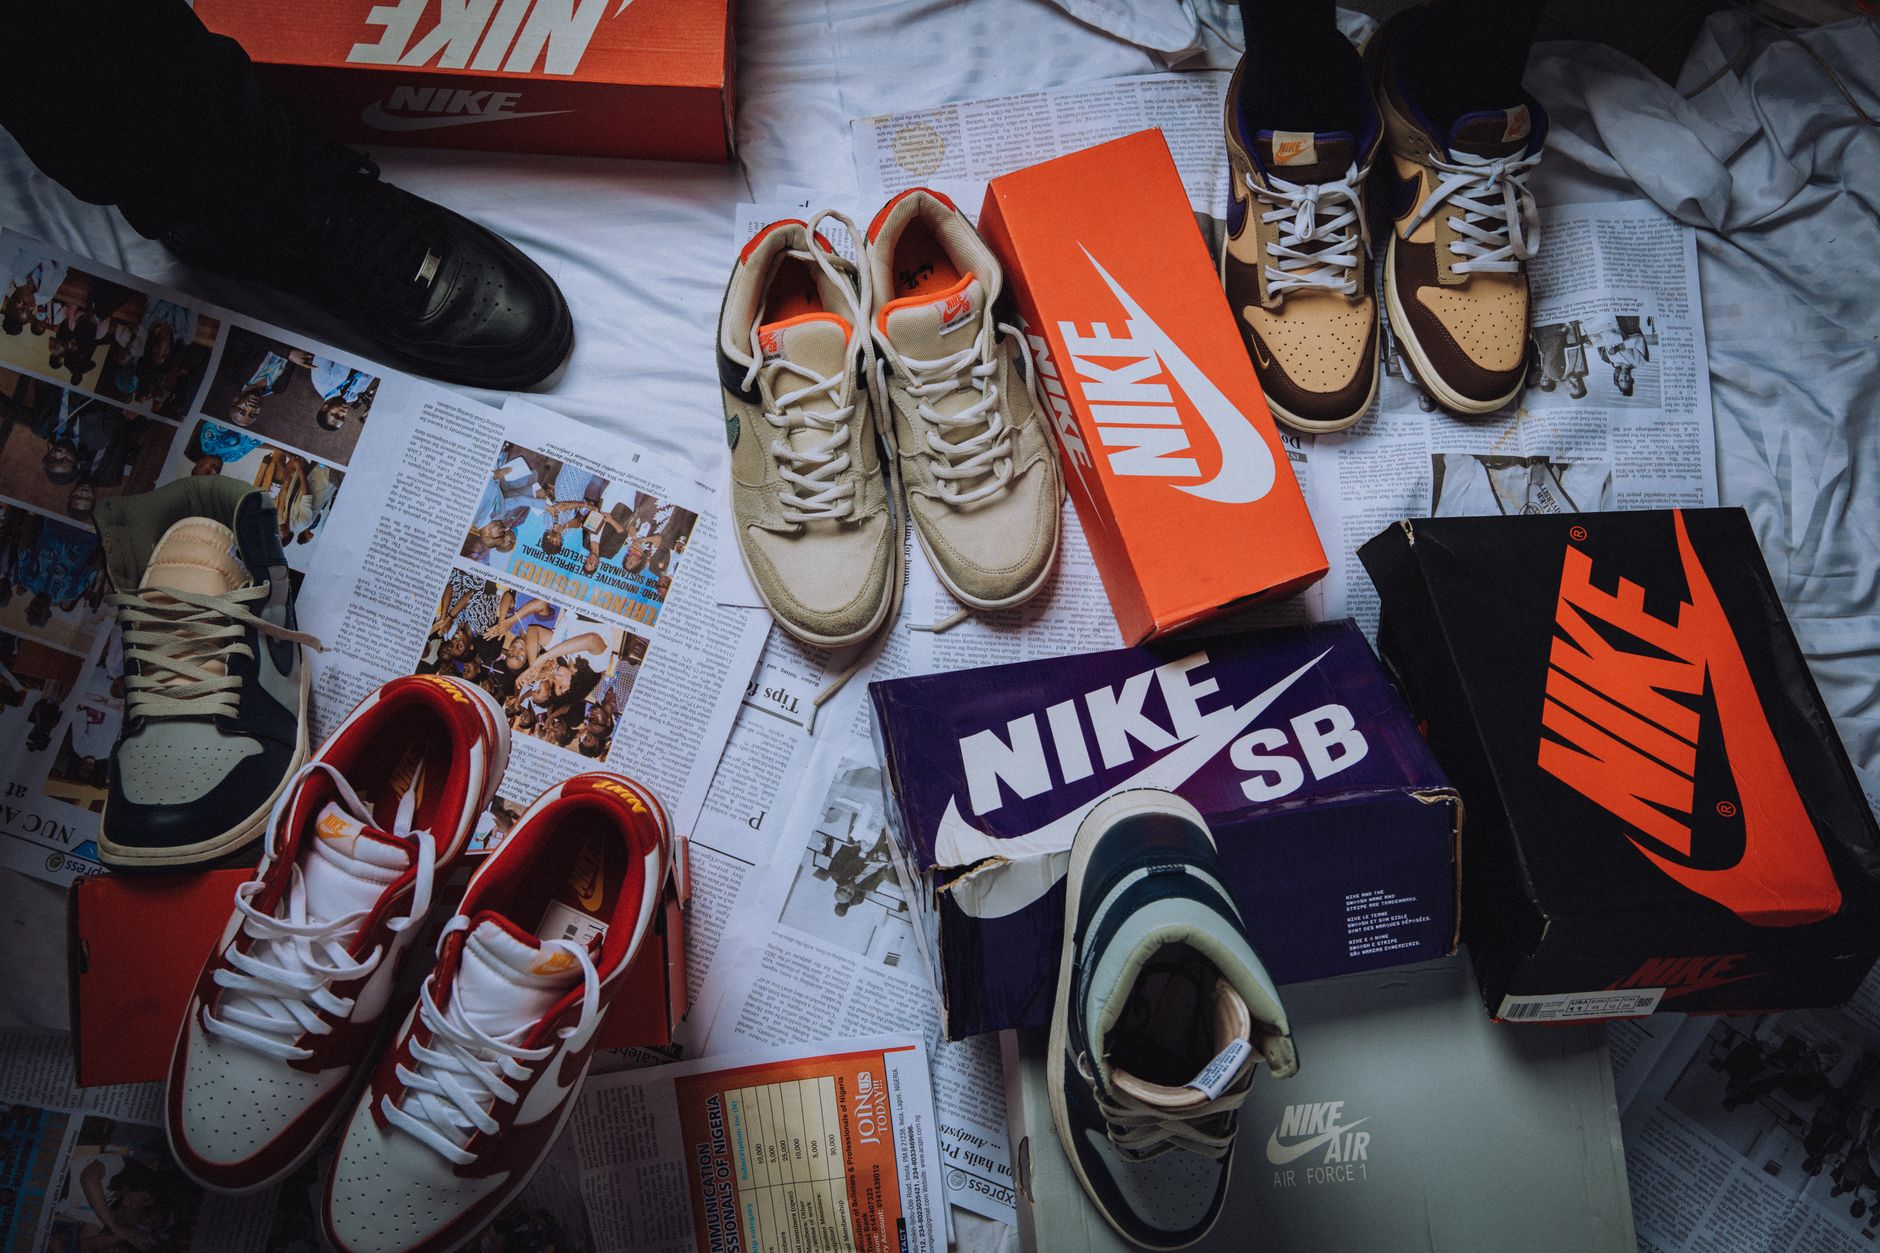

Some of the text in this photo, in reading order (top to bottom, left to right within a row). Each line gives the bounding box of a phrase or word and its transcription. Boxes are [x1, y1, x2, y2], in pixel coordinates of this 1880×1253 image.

[345, 0, 609, 76] NIKE
[386, 86, 522, 114] NIKE
[1278, 140, 1301, 153] NIKE
[1027, 334, 1093, 469] NIKE
[1057, 320, 1203, 477] NIKE
[594, 571, 639, 595] INNOVATIVE
[597, 560, 644, 584] SUSTAINABL
[761, 682, 803, 714] Tips
[1537, 544, 1703, 857] NIKE
[959, 651, 1236, 816] NIKE
[1230, 703, 1369, 802] SB
[4, 781, 28, 800] at
[0, 803, 75, 845] NUC A
[1635, 957, 1750, 986] NIKE
[837, 1075, 846, 1102] Nigeria
[840, 1104, 845, 1112] of
[852, 1088, 879, 1145] JOIN
[873, 1078, 888, 1135] TODAY!!!
[1276, 1100, 1346, 1137] NIKE
[706, 1093, 726, 1154] NIGERIA
[841, 1113, 853, 1165] Professionals
[937, 1122, 988, 1148] Analysts
[755, 1142, 763, 1164] 10,000
[828, 1133, 836, 1156] 30,000
[962, 1149, 994, 1171] hails
[1321, 1131, 1371, 1163] AIR
[715, 1155, 729, 1178] OF
[1272, 1163, 1367, 1188] AIR FORCE 1
[848, 1174, 858, 1207] Scholars
[967, 1178, 1018, 1206] xpress
[877, 1208, 887, 1242] Account:
